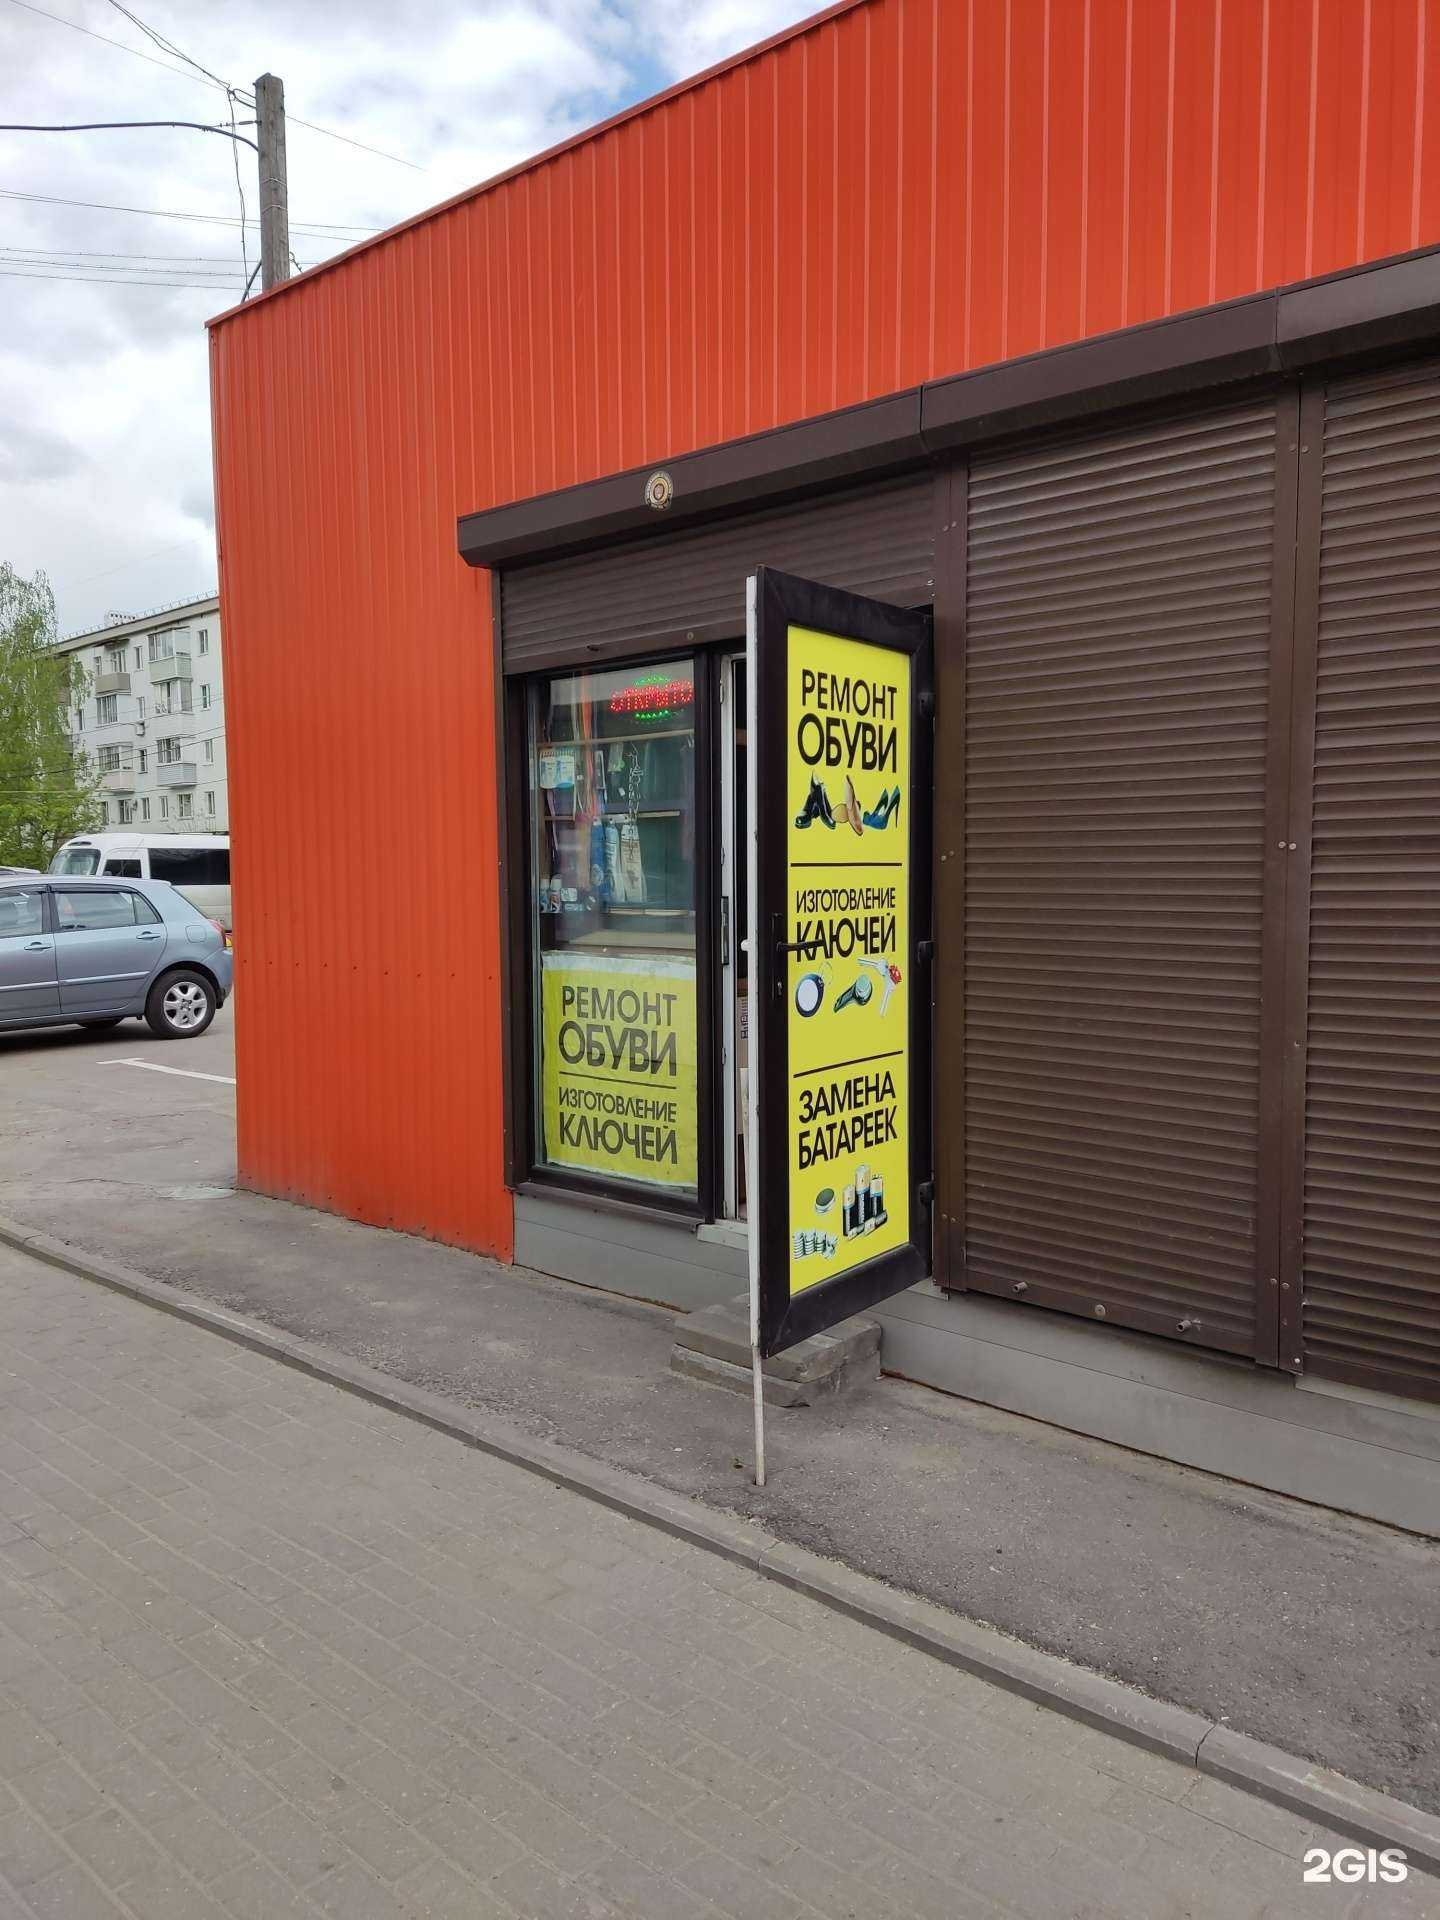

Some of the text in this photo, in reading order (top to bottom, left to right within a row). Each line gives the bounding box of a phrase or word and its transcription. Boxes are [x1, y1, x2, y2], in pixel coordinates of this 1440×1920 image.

[802, 668, 897, 720] РЕМОНТ
[797, 713, 897, 773] ОБУВИ
[796, 887, 896, 913] ИЗГОТОВЛЕНИЕ
[796, 913, 896, 962] КЛЮЧЕЙ
[561, 985, 677, 1026] РЕМОНТ
[558, 1020, 677, 1076] ОБУВИ
[559, 1087, 677, 1123] ИЗГОТОВЛЕНИЕ
[798, 1071, 896, 1124] ЗАМЕНА
[559, 1112, 678, 1165] КЛЮЧЕЙ
[798, 1105, 898, 1170] БАТАРЕЕК
